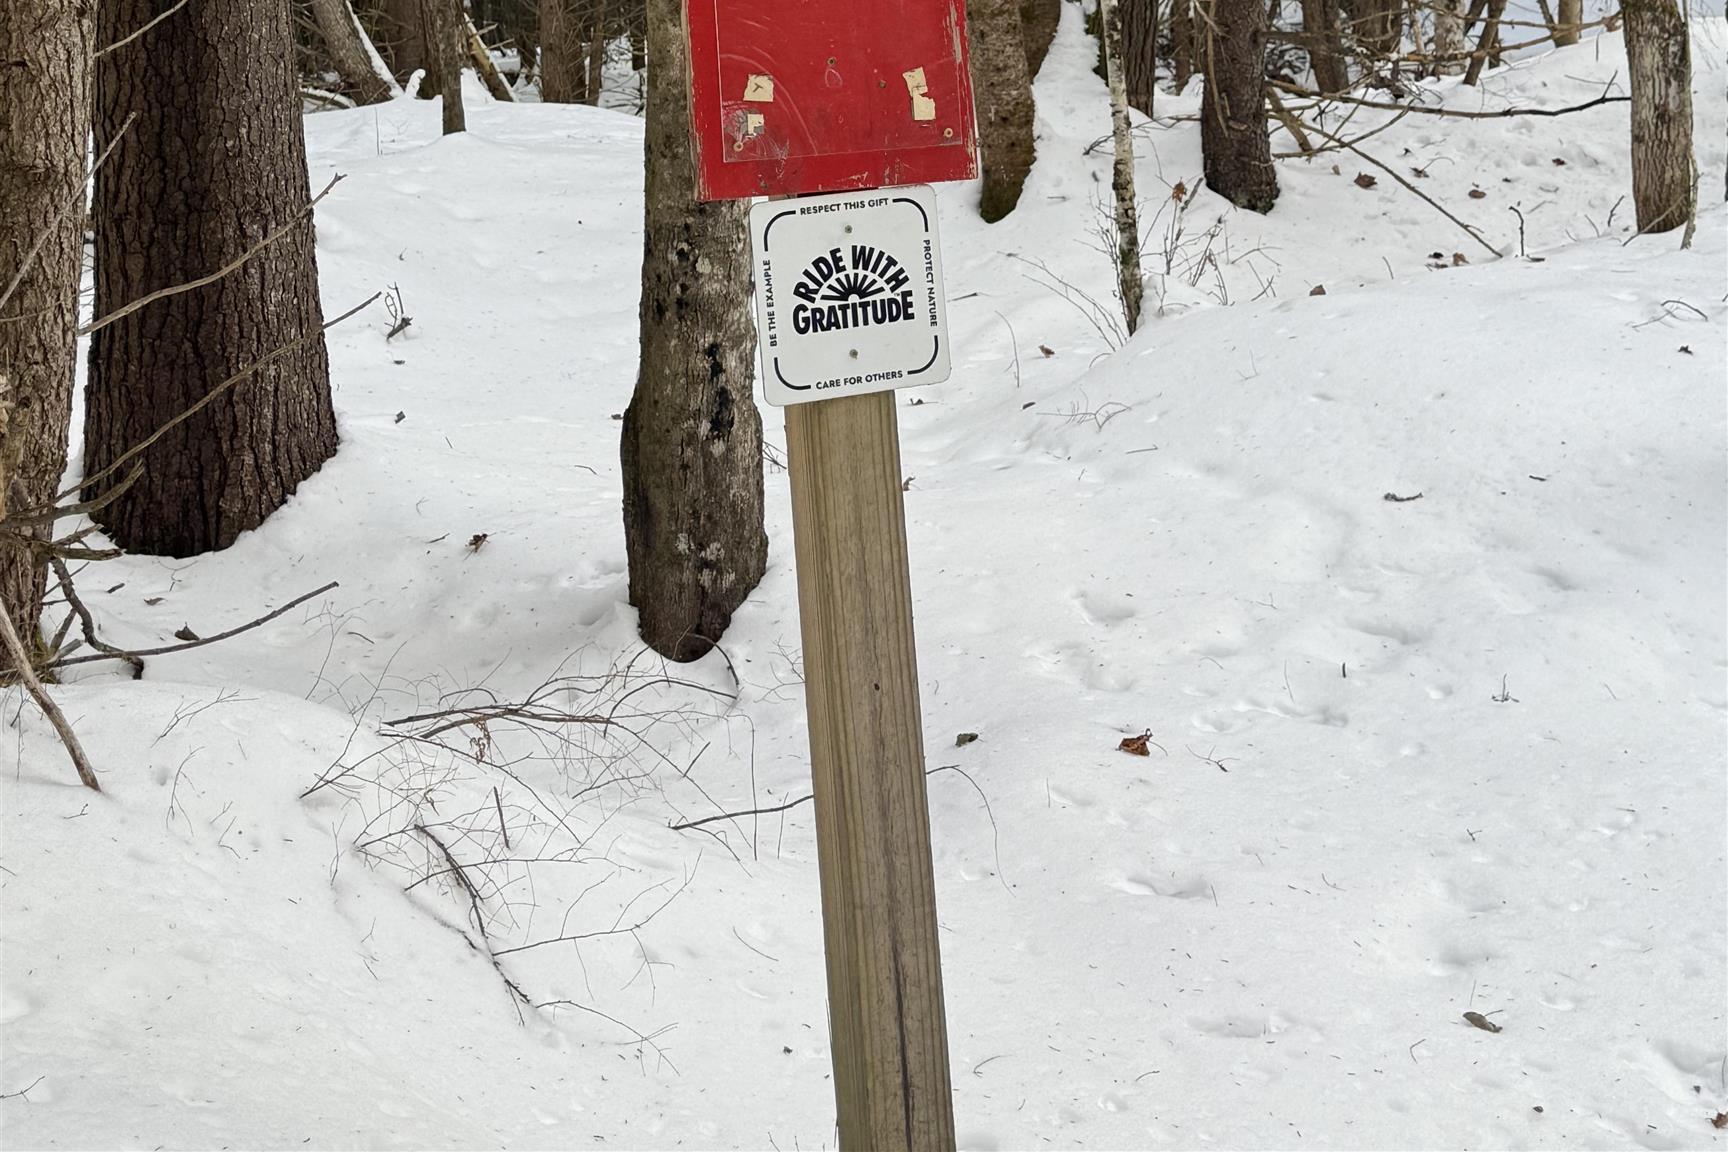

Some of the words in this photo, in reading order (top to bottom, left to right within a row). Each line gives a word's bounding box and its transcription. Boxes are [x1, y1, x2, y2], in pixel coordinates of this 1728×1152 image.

[800, 202, 841, 215] RESPECT
[843, 201, 866, 211] THIS
[868, 198, 889, 208] GIFT
[793, 247, 847, 304] RIDE
[851, 245, 910, 293] WITH
[923, 239, 935, 285] PROTECT
[762, 259, 775, 308] EXAMPLE
[768, 310, 776, 332] THE
[792, 289, 915, 335] GRATITUDE
[927, 287, 938, 327] NATURE
[769, 333, 778, 347] BE
[816, 378, 841, 390] CARE
[843, 376, 863, 386] FOR
[865, 371, 903, 383] OTHERS
